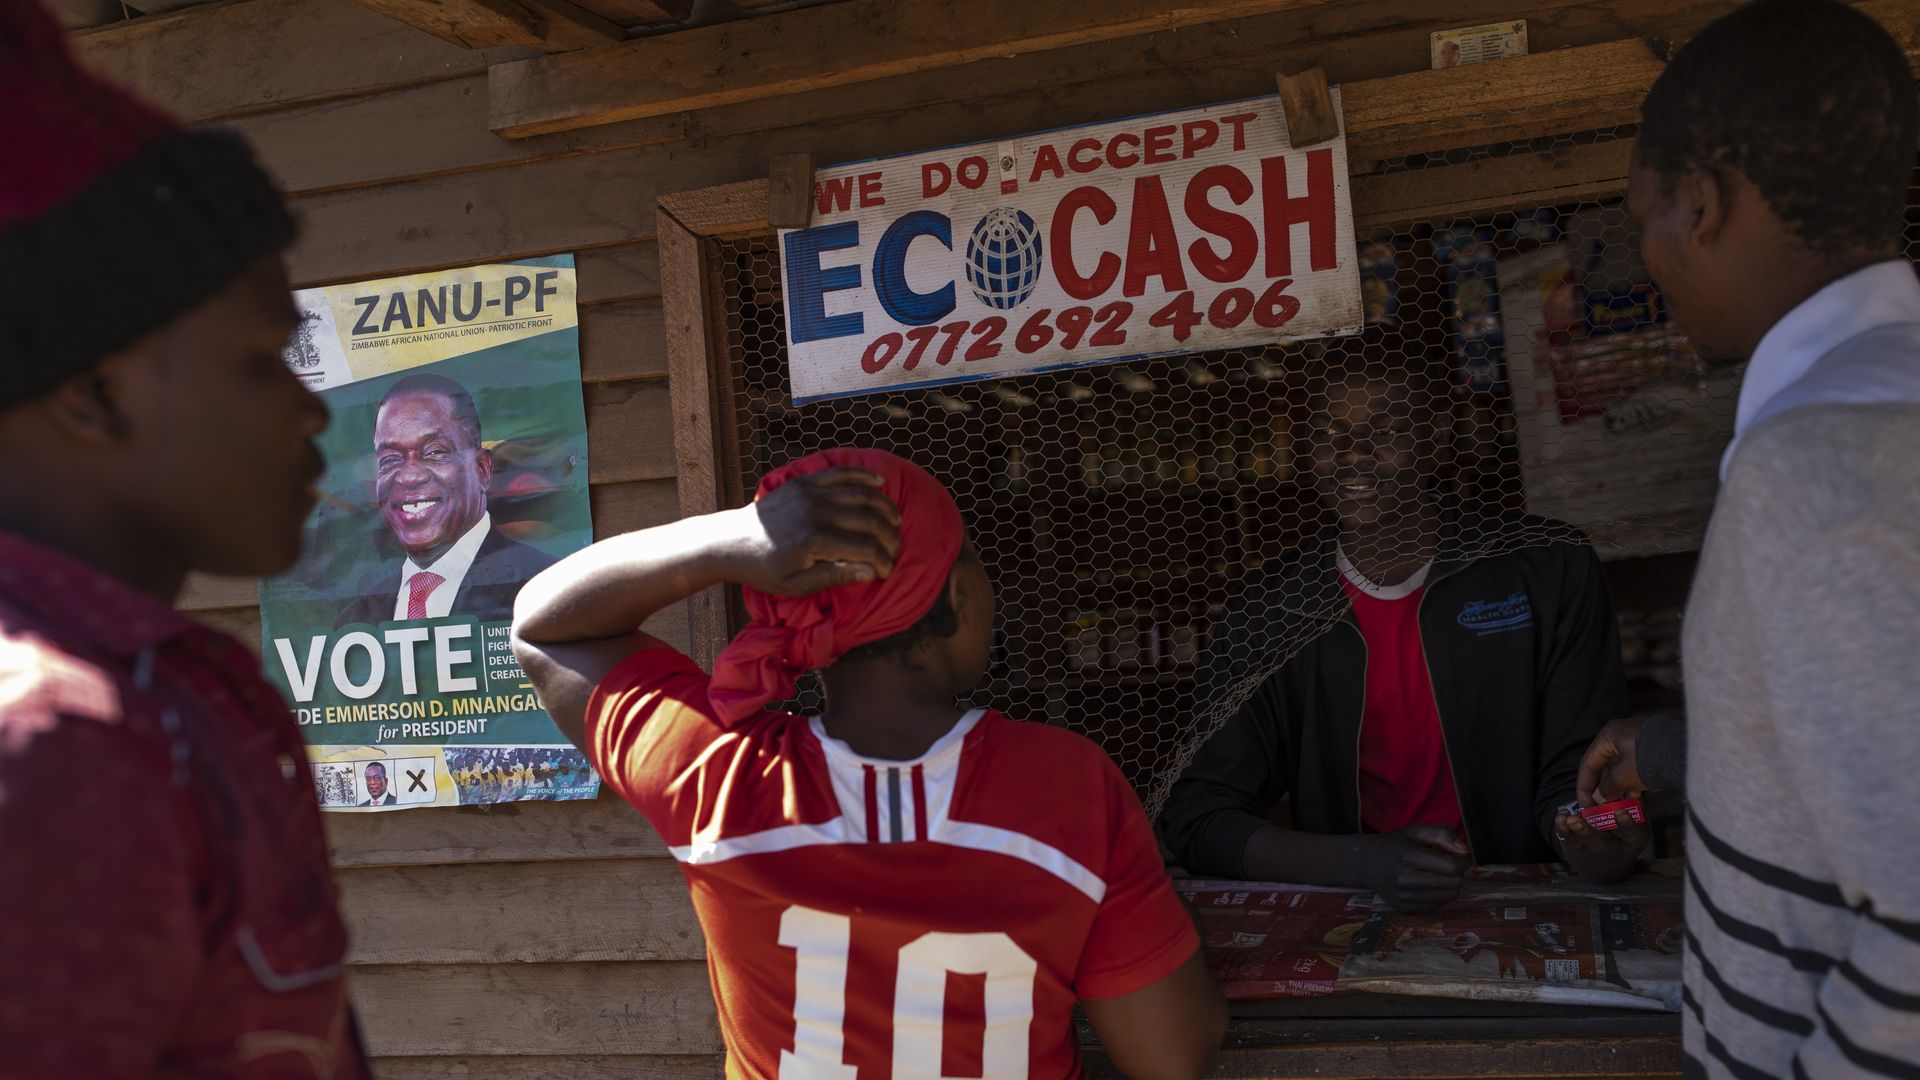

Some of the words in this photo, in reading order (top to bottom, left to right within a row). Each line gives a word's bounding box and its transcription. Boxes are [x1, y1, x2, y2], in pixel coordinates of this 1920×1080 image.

[815, 172, 886, 215] WE
[922, 156, 989, 198] DO
[1029, 112, 1260, 183] ACCEPT
[351, 271, 558, 336] ZANU-PF
[351, 339, 390, 350] ZIMBABWE
[391, 335, 422, 346] AFRICAN
[424, 330, 459, 341] NATIONAL
[489, 322, 526, 333] PATRIOTIC
[528, 319, 552, 328] FRONT
[861, 316, 1007, 375] 0772
[1015, 301, 1134, 355] 692
[1149, 279, 1300, 342] 406
[487, 626, 511, 637] UNIT
[488, 641, 512, 652] FIGH
[273, 624, 477, 702] VOTE
[490, 669, 526, 680] CREATE
[325, 700, 426, 724] EMMERSON
[430, 700, 448, 718] D.
[452, 693, 545, 716] MNANGA
[376, 724, 398, 743] for
[402, 718, 487, 738] PRESIDENT
[777, 904, 1038, 1080] 10
